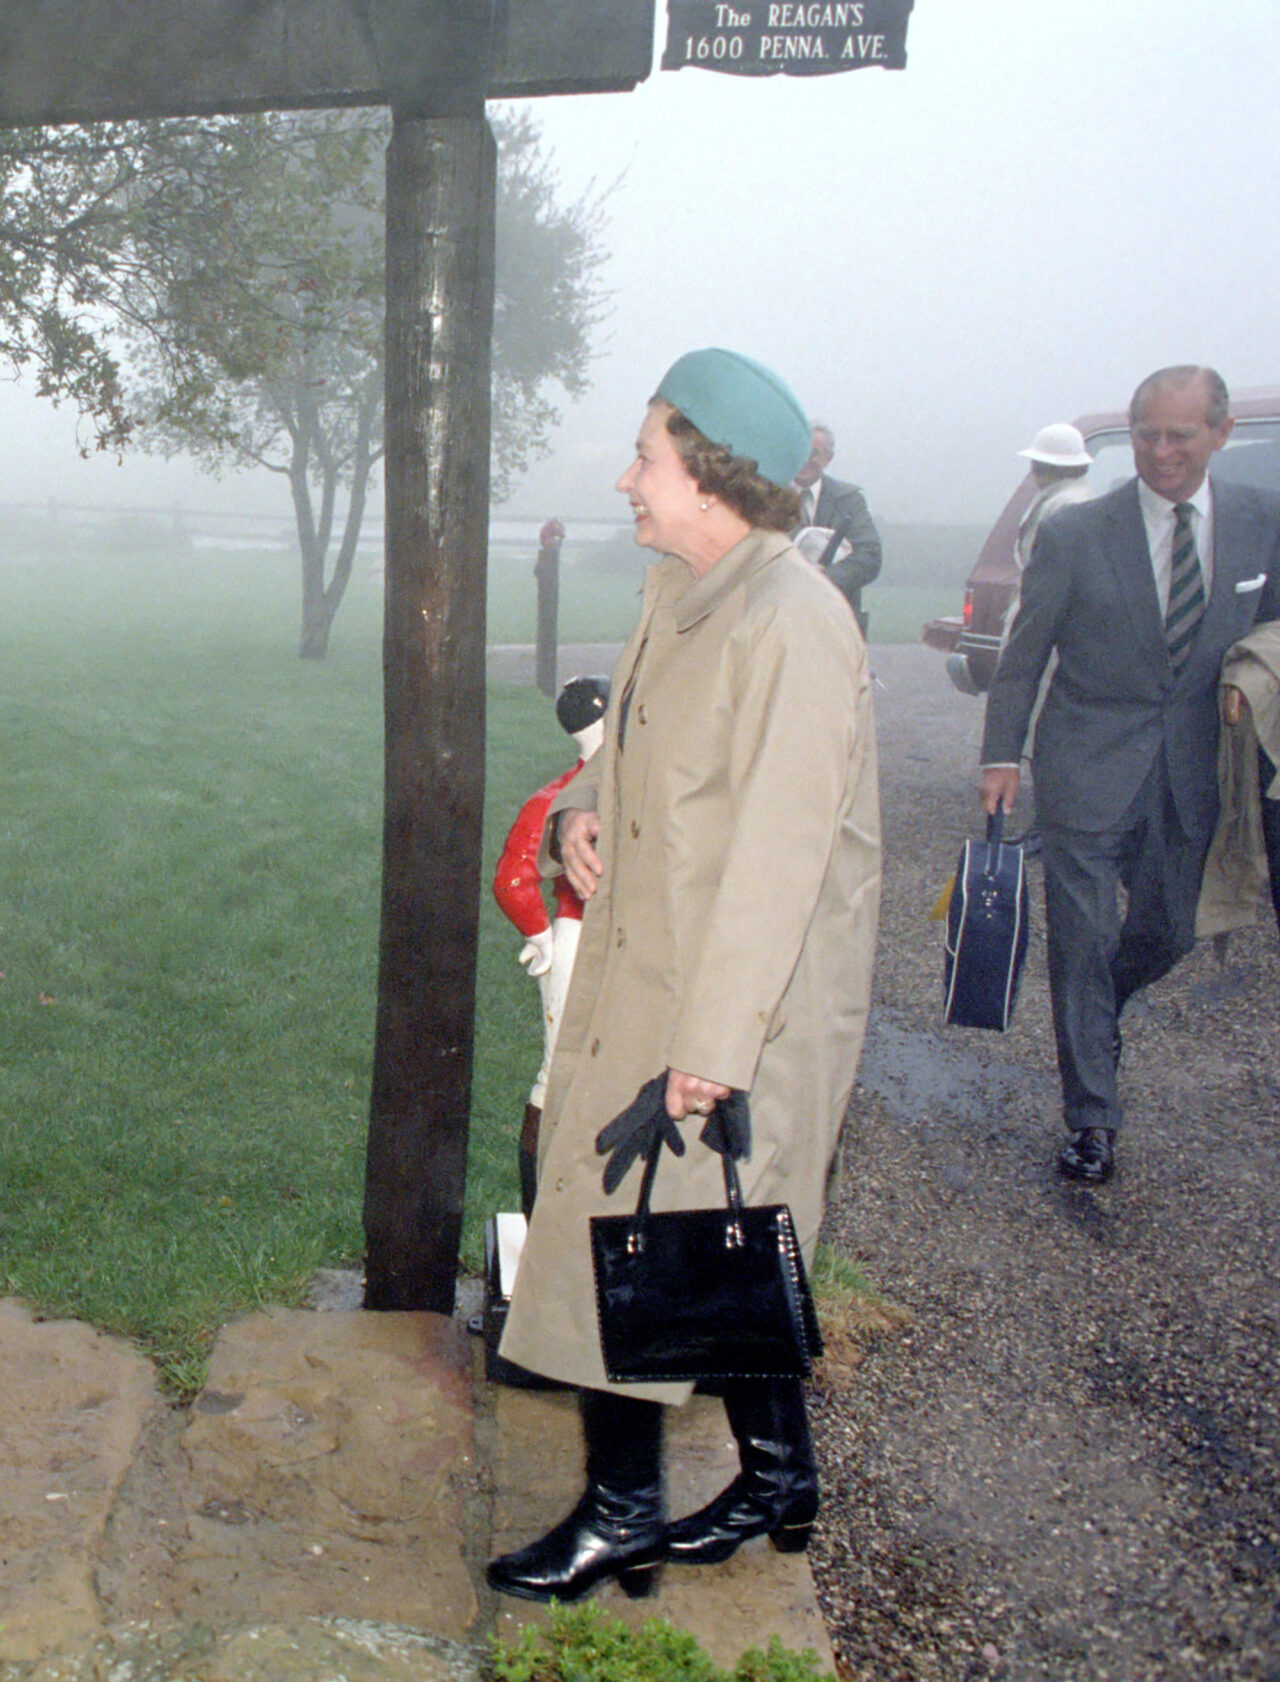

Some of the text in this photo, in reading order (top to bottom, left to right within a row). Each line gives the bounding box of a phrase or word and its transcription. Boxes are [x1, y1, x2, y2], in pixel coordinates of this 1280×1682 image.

[715, 3, 865, 28] The REAGAN'S
[685, 35, 888, 60] 1600 PENNA. AVE.
